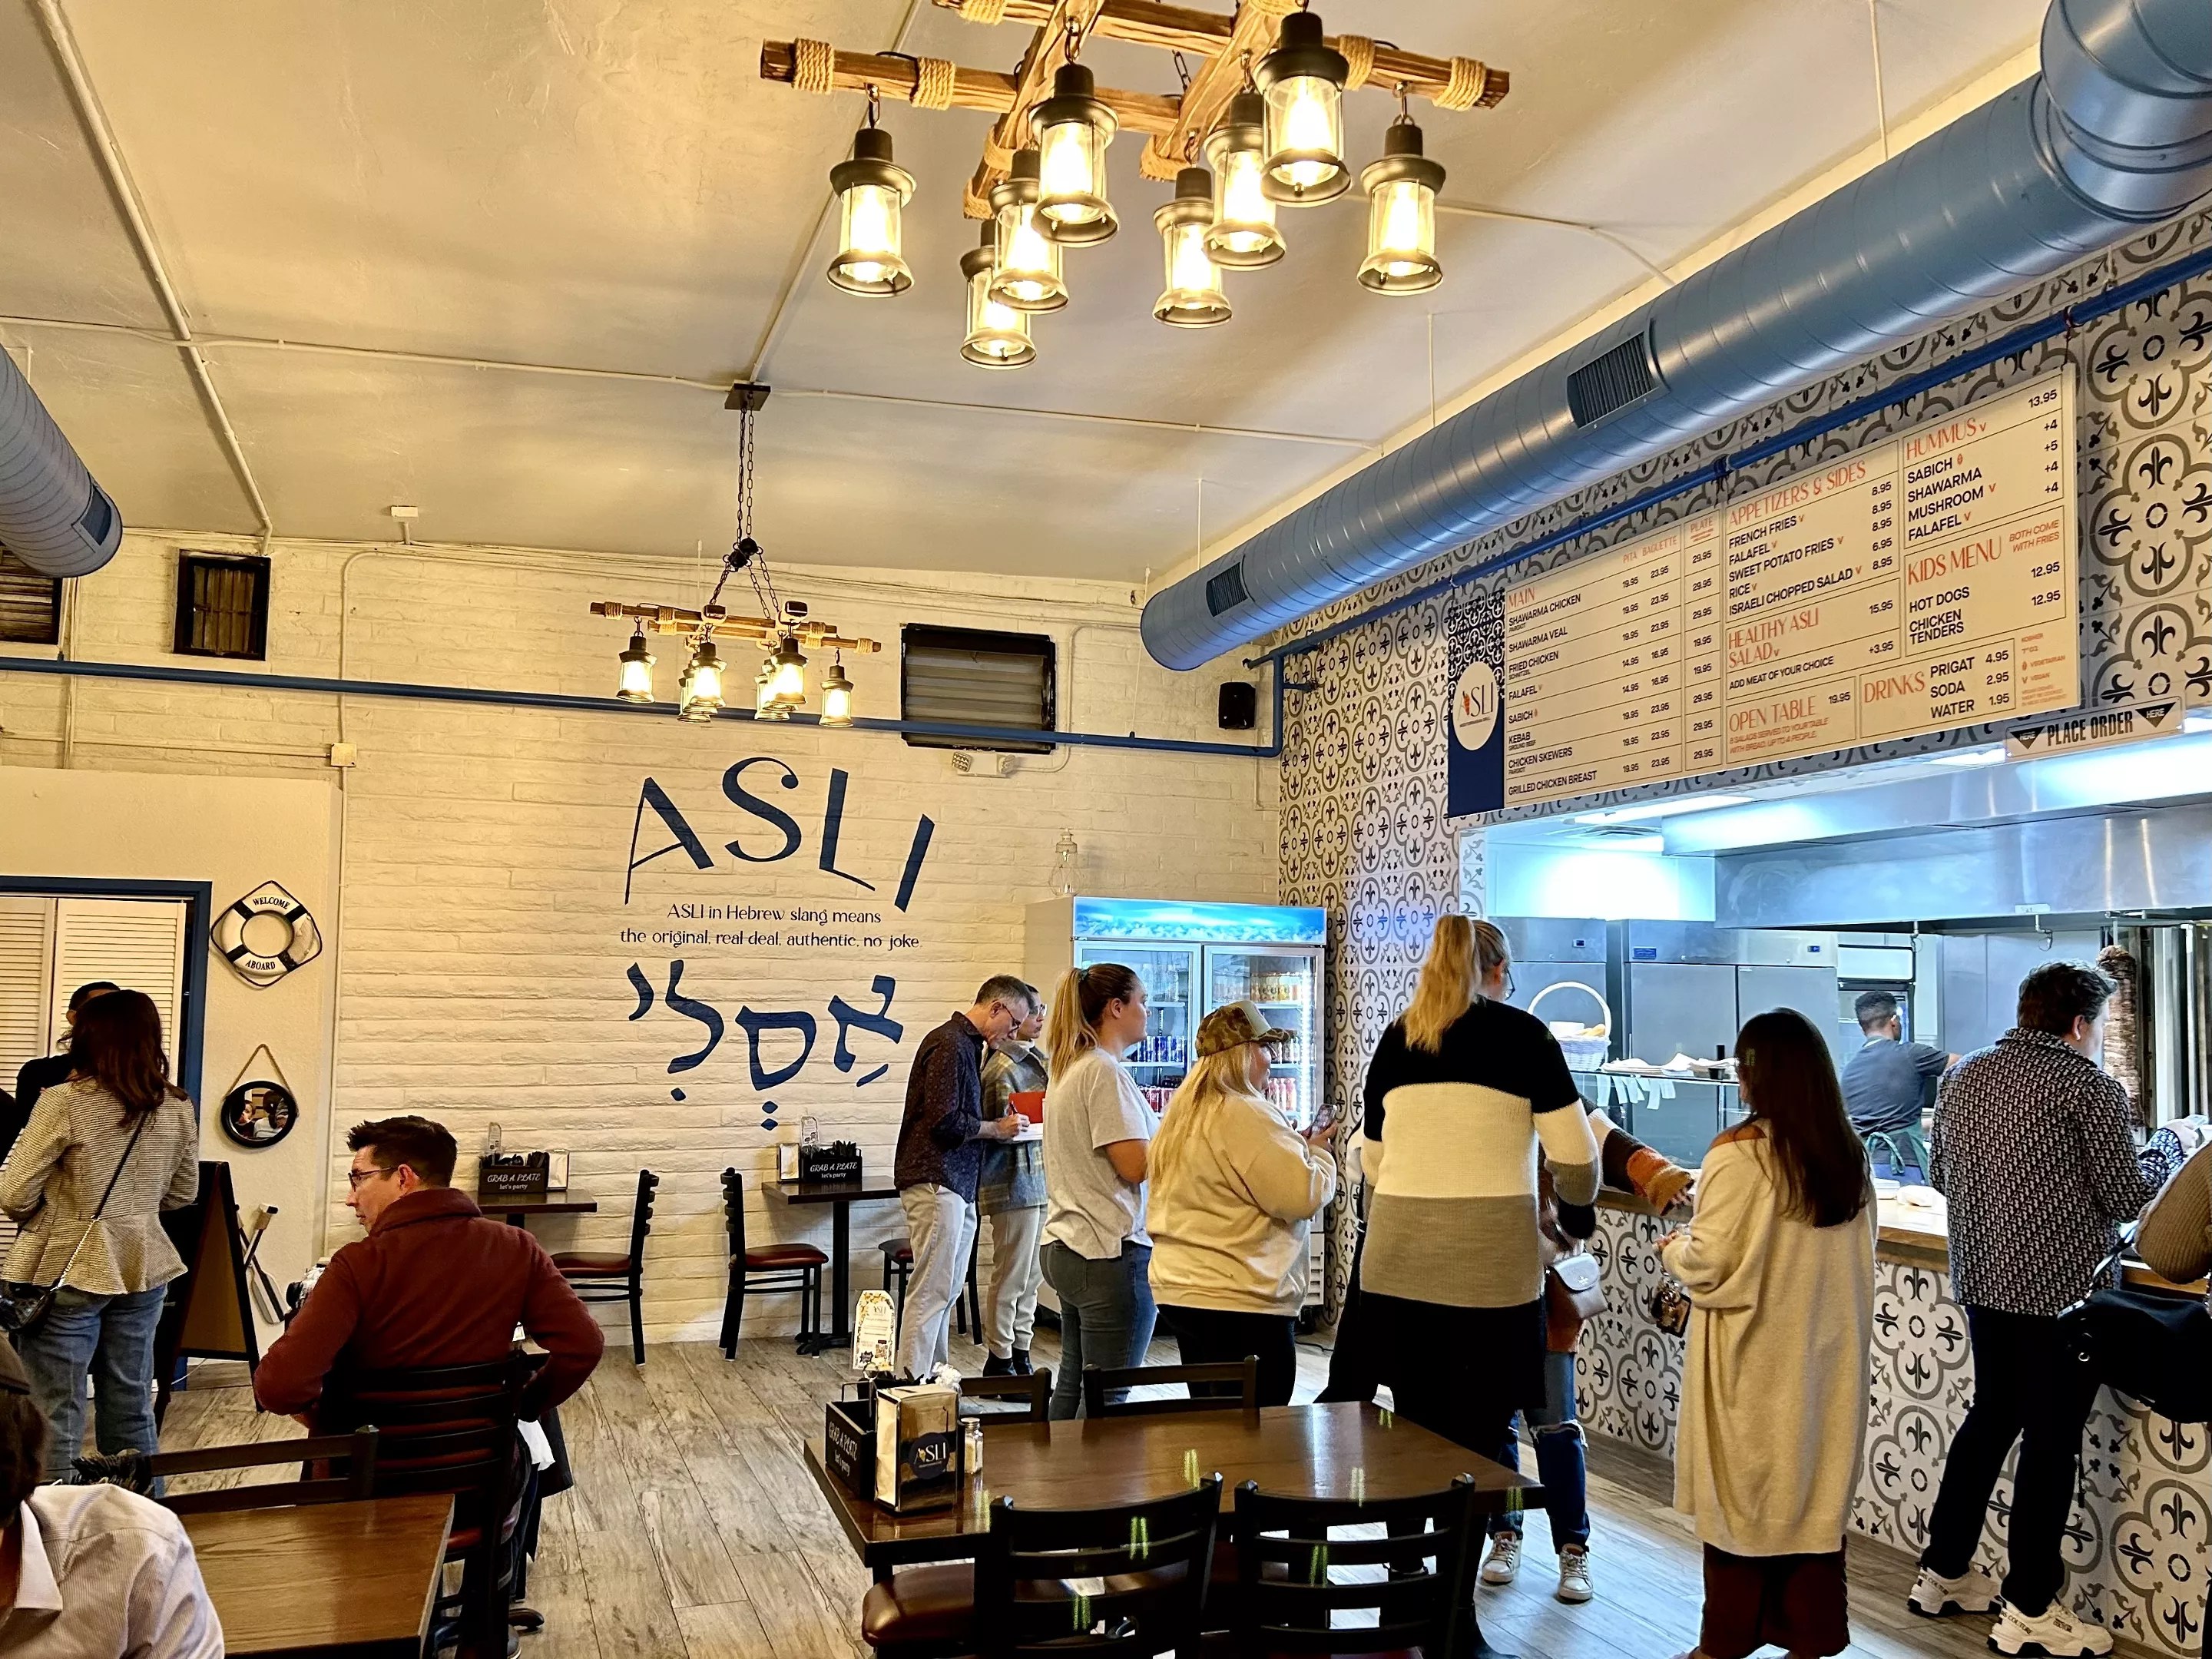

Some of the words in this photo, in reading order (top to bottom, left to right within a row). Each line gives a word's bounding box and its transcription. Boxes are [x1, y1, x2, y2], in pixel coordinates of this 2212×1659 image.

[1906, 417, 1976, 460] HUMMUS
[2028, 389, 2057, 408] 13.95
[1908, 458, 1952, 484] SABICH
[2044, 419, 2058, 431] +4
[1908, 468, 1982, 503] SHAWARMA
[2045, 440, 2058, 452] +5
[1730, 482, 1809, 527] APPETIZERS
[1813, 477, 1822, 495] &
[1827, 460, 1866, 490] SIDES
[1909, 485, 1983, 522] MUSHROOM
[2045, 461, 2058, 472] +4
[1909, 514, 1962, 541] FALAFEL
[2045, 482, 2058, 493] +4
[1690, 516, 1714, 533] PLATE
[1729, 526, 1766, 549] FRENCH
[1769, 515, 1796, 535] FRIES
[1872, 482, 1892, 495] 8.95
[1729, 543, 1770, 565] FALAFEL
[1872, 500, 1892, 514] 8.95
[2009, 527, 2032, 542] BOTH
[2033, 519, 2059, 535] COME
[1623, 552, 1637, 563] PITA
[1642, 535, 1677, 556] BAGUETTE
[1729, 562, 1762, 582] SWEET
[1764, 549, 1803, 571] POTATO
[1805, 538, 1833, 557] FRIES
[1872, 517, 1892, 531] 8.95
[1908, 555, 1945, 585] KIDS
[1950, 535, 2002, 573] MENU
[2013, 539, 2034, 553] WITH
[2035, 531, 2060, 545] FRIES
[1509, 605, 1548, 626] SHAWARMA
[1550, 594, 1581, 611] CHICKEN
[1623, 577, 1638, 588] 19.95
[1651, 565, 1669, 578] 23.95
[1693, 550, 1711, 564] 29.95
[1729, 583, 1750, 598] RICE
[1873, 538, 1892, 551] 6.95
[1730, 597, 1765, 615] ISRAELI
[1767, 582, 1814, 604] CHOPPED
[1816, 568, 1853, 588] SALAD
[1873, 556, 1892, 570] 8.95
[1909, 597, 1933, 613] HOT
[1936, 587, 1969, 605] DOGS
[2031, 561, 2060, 578] 12.95
[1508, 587, 1535, 608] MAIN
[1509, 633, 1548, 652] SHAWARMA
[1549, 627, 1568, 639] VEAL
[1623, 603, 1638, 614] 19.95
[1651, 593, 1669, 605] 23.95
[1693, 578, 1711, 591] 29.95
[1909, 609, 1961, 633] CHICKEN
[2032, 590, 2061, 606] 12.95
[1509, 661, 1527, 674] FRIED
[1528, 651, 1558, 667] CHICKEN
[1623, 630, 1638, 641] 19.95
[1651, 620, 1669, 633] 23.95
[1693, 607, 1711, 620] 29.95
[1728, 618, 1786, 650] HEALTHY
[1790, 608, 1819, 632] ASLI
[1869, 601, 1892, 614] 15.95
[1910, 621, 1964, 644] TENDERS
[1509, 685, 1538, 700] FALAFEL
[1622, 657, 1639, 667] 14.95
[1651, 647, 1668, 659] 16.95
[1694, 635, 1711, 647] 19.95
[1729, 642, 1773, 669] SALAD
[1730, 679, 1745, 690] ADD
[1747, 673, 1767, 686] MEAT
[1768, 669, 1778, 680] OF
[1780, 664, 1802, 677] YOUR
[1803, 656, 1833, 671] CHOICE
[1869, 641, 1893, 654] +3.95
[1930, 657, 1975, 678] PRIGAT
[1985, 650, 2008, 664] 4.95
[1457, 682, 1493, 720] ASLI
[1508, 710, 1533, 724] SABICH
[1622, 683, 1639, 694] 14.95
[1651, 675, 1668, 686] 16.95
[1694, 663, 1712, 674] 19.95
[1864, 671, 1925, 704] DRINKS
[1930, 680, 1965, 698] SODA
[1986, 671, 2009, 685] 2.95
[1931, 700, 1975, 719] WATER
[1989, 693, 2010, 706] 1.95
[1508, 732, 1530, 744] KEBAB
[1623, 710, 1638, 720] 19.95
[1651, 703, 1669, 714] 23.95
[1694, 692, 1713, 704] 29.95
[1730, 708, 1766, 732] OPEN
[1771, 695, 1816, 723] TABLE
[1829, 692, 1850, 704] 19.95
[2048, 719, 2086, 747] PLACE
[2091, 710, 2133, 739] ORDER
[2146, 708, 2165, 718] HERE
[1508, 754, 1537, 768] CHICKEN
[1539, 747, 1572, 761] SKEWERS
[1623, 737, 1638, 747] 19.95
[1651, 730, 1669, 740] 23.95
[1694, 720, 1713, 731] 29.95
[1508, 783, 1535, 795] GRILLED
[1537, 777, 1568, 790] CHICKEN
[1569, 770, 1597, 784] BREAST
[1623, 763, 1639, 773] 19.95
[1651, 757, 1670, 767] 23.95
[1694, 749, 1713, 760] 29.95
[624, 756, 935, 913] ASLI
[253, 897, 290, 909] WELCOME
[667, 904, 704, 919] ASLI
[709, 906, 721, 919] in
[727, 905, 785, 921] Hebrew
[790, 908, 828, 926] slang
[833, 912, 881, 923] means
[620, 929, 646, 942] the
[717, 932, 743, 945] real
[864, 936, 882, 946] no
[245, 960, 275, 970] ABOARD
[488, 1174, 508, 1183] GRAB
[836, 1162, 857, 1171] PLATE
[914, 1442, 946, 1465] ASLI
